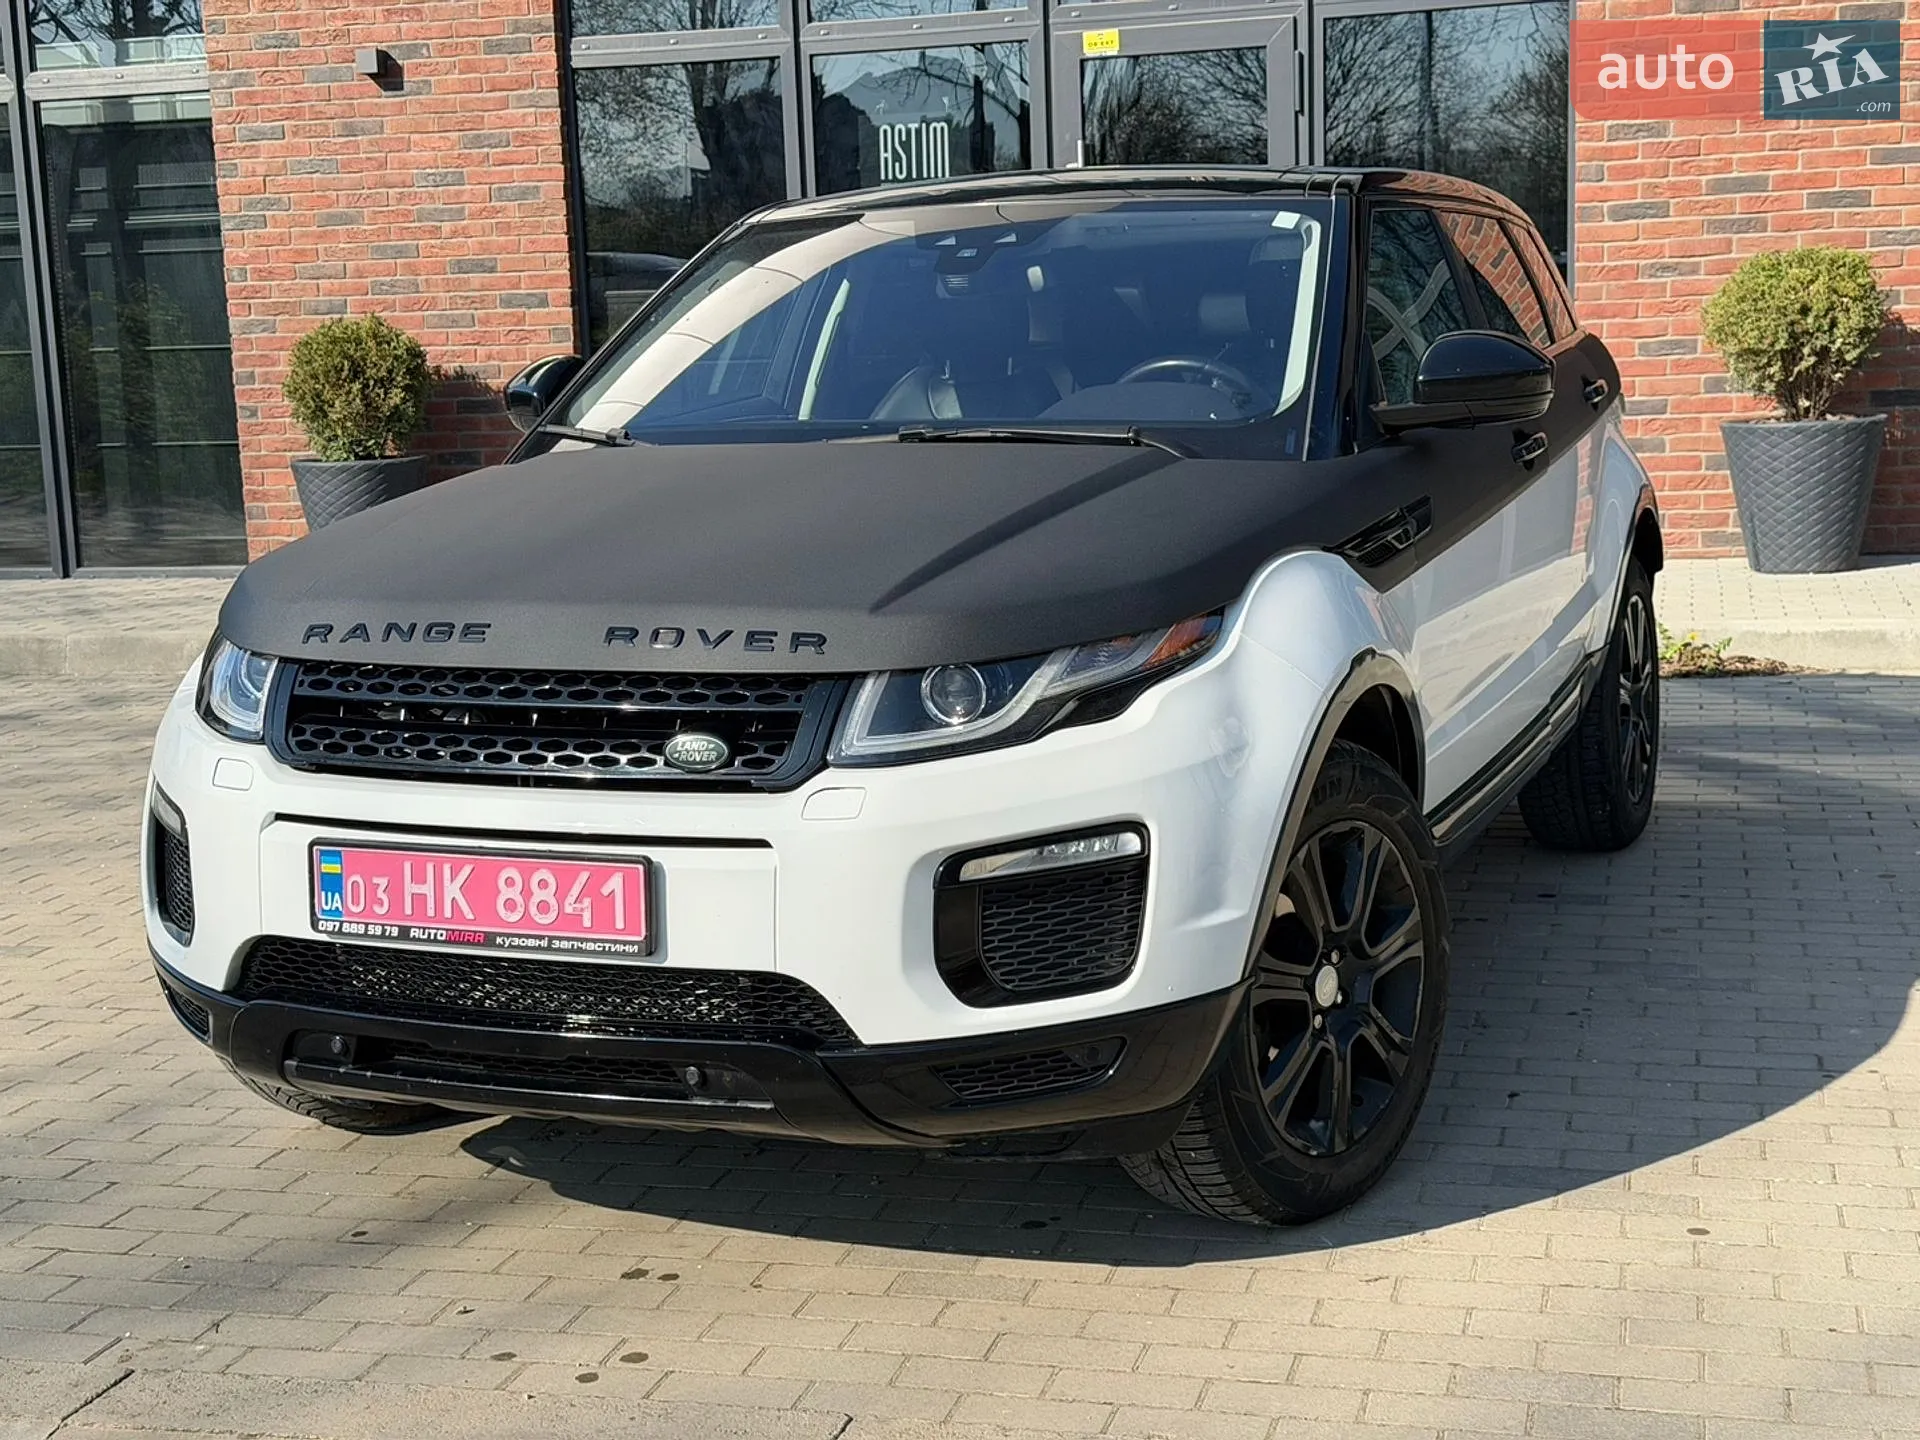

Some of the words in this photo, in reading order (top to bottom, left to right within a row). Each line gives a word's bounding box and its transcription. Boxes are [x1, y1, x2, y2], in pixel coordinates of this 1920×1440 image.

[879, 121, 950, 180] ASTIM
[301, 622, 492, 645] RANGE
[603, 626, 828, 655] ROVER
[676, 740, 708, 751] LAND
[679, 750, 718, 762] ROVER
[321, 890, 343, 912] UA
[496, 866, 626, 930] 8841
[318, 920, 340, 932] 097
[342, 922, 366, 934] 889
[367, 924, 383, 936] 59
[384, 925, 399, 937] 79
[495, 936, 549, 948] кузовні
[551, 939, 639, 953] запчастини
